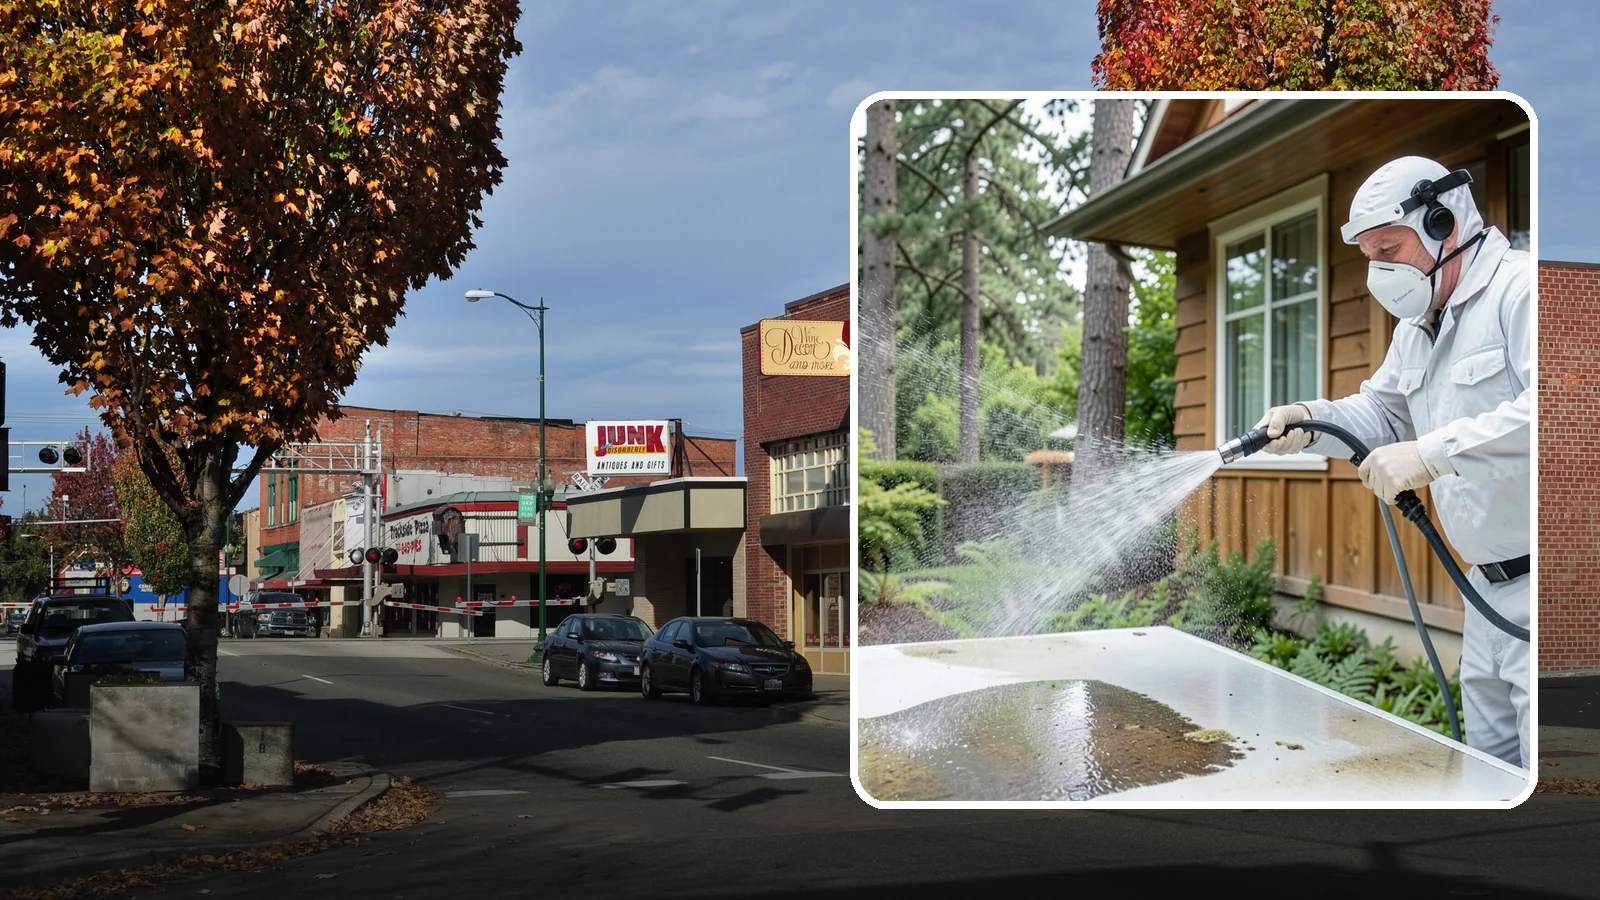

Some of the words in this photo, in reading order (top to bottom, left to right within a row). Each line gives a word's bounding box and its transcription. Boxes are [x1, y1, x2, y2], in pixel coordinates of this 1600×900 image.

[595, 425, 664, 457] JUNK
[607, 446, 646, 454] DISORDERLY
[597, 461, 628, 470] ANTIQUES
[631, 461, 644, 470] AND
[647, 460, 665, 470] GIFTS
